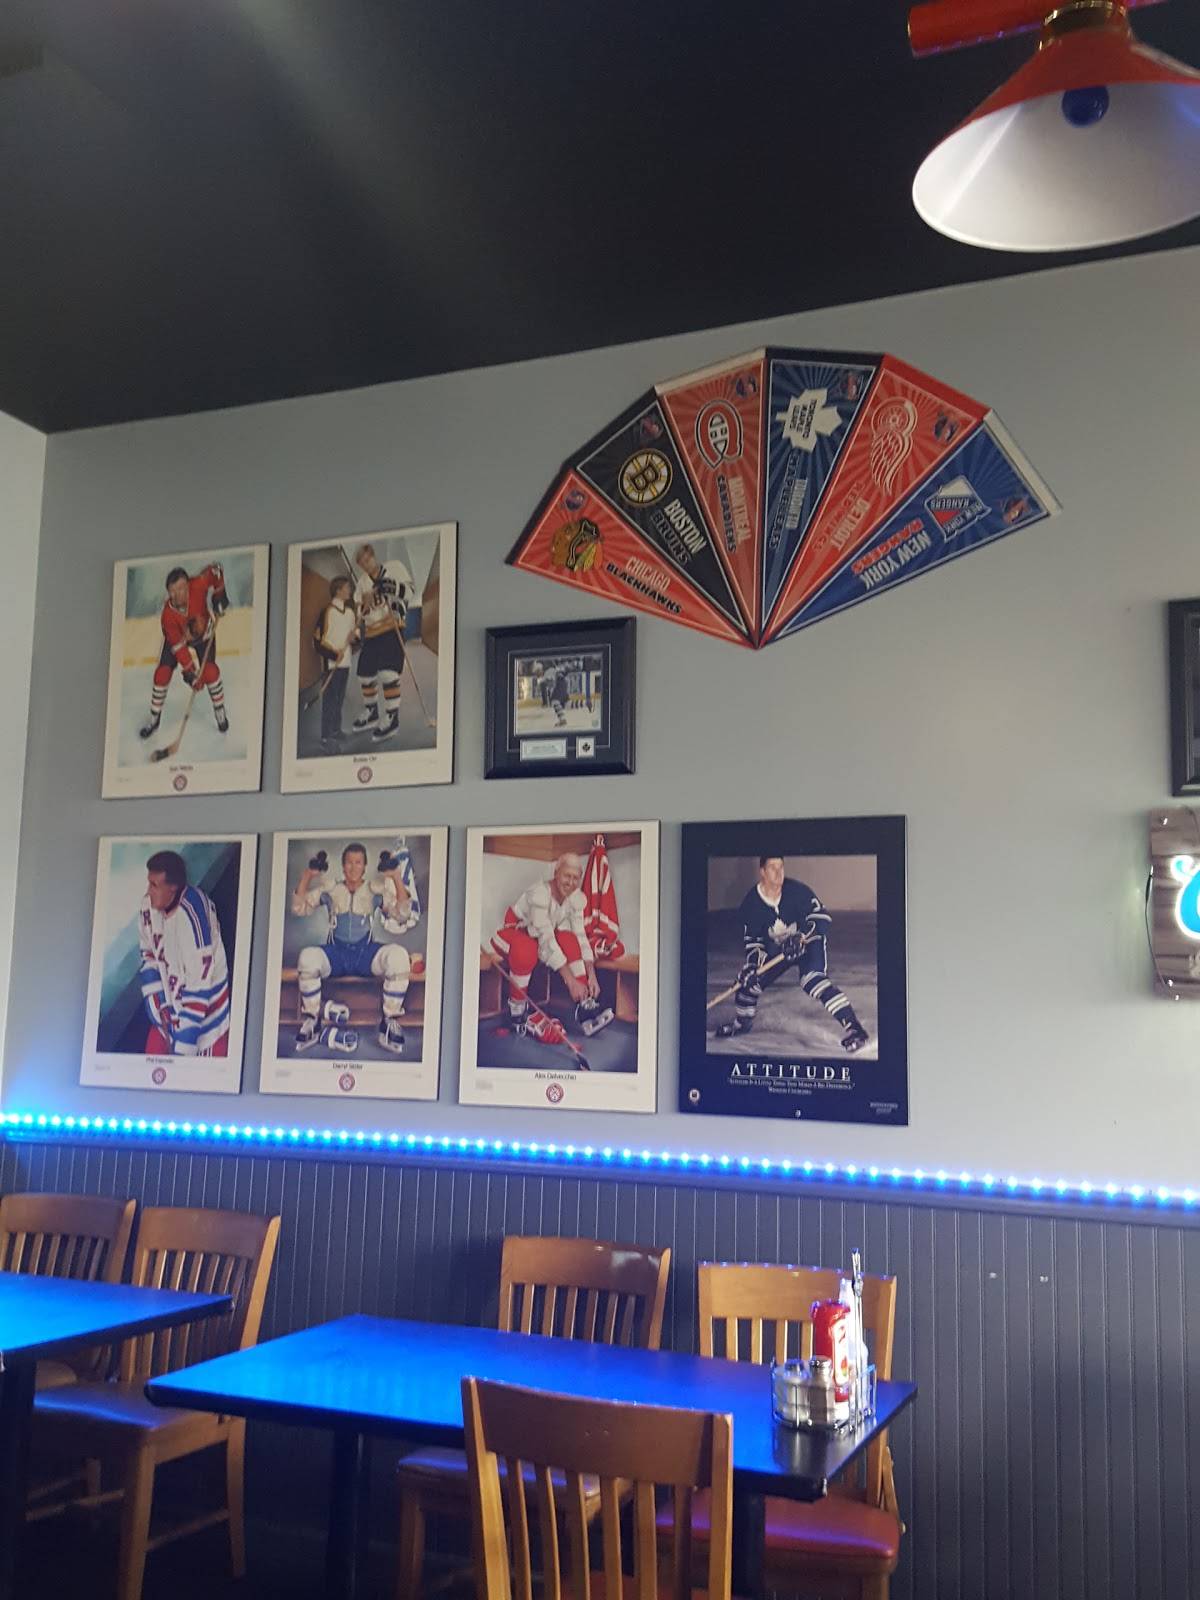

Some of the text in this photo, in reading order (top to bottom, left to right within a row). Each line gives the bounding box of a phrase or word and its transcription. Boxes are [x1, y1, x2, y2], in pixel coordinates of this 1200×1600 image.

[663, 498, 707, 555] BOSTON
[728, 476, 752, 544] MONTREAL
[830, 497, 871, 551] DETROIT
[930, 498, 970, 510] RANGERS
[651, 510, 691, 565] BRUINS
[860, 530, 932, 590] NEW YORK
[606, 562, 682, 614] BLACKHAWKS
[625, 556, 671, 591] CHICAGO
[201, 955, 213, 980] 7
[731, 1062, 851, 1082] ATTITUDE
